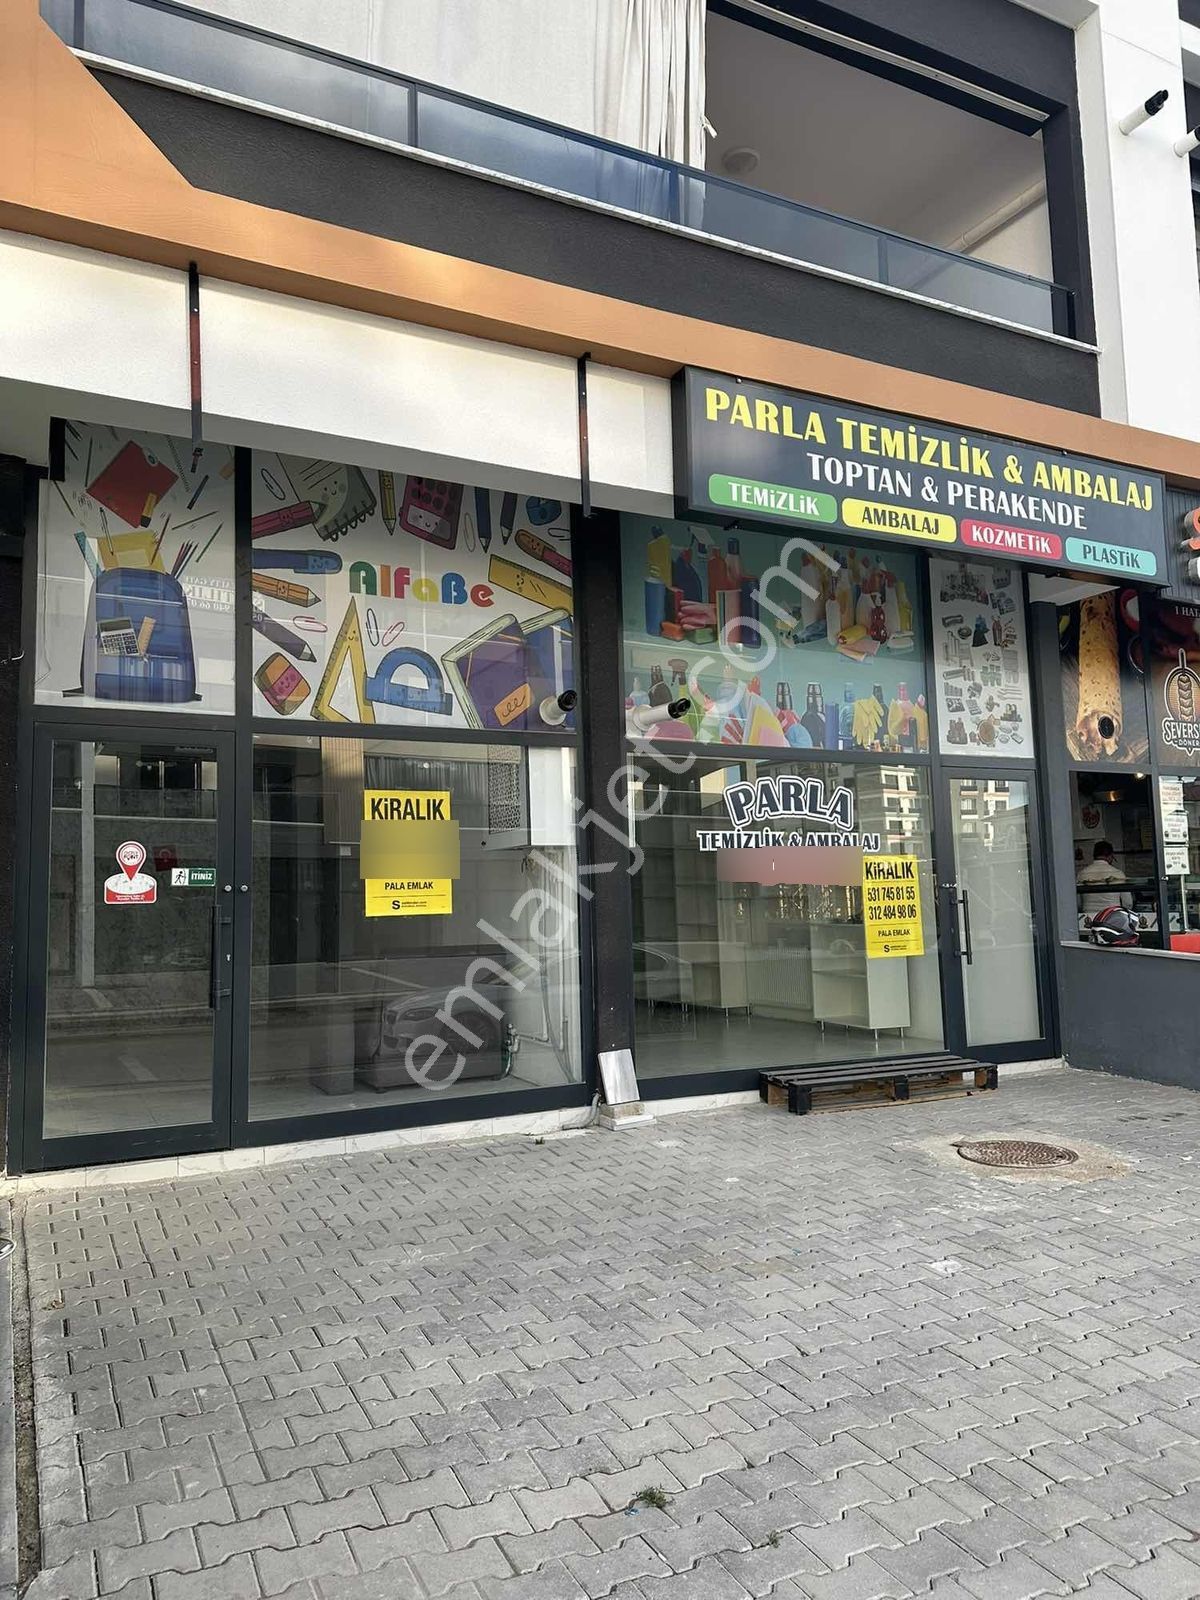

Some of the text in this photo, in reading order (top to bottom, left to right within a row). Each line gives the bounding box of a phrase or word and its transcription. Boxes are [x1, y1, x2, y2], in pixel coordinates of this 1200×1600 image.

[705, 387, 1153, 512] PARLA TEMİZLİK & AMBALAJ
[806, 452, 1087, 531] TOPTAN & PERAKENDE
[861, 506, 940, 536] AMBALAJ
[1164, 720, 1200, 741] SEVERS
[724, 776, 853, 830] PARLA
[788, 832, 803, 847] &
[384, 881, 433, 890] PALA EMLAK
[867, 886, 915, 901] 531 745 81 55
[868, 904, 916, 920] 312 484 98 06
[893, 929, 910, 937] EMLAK
